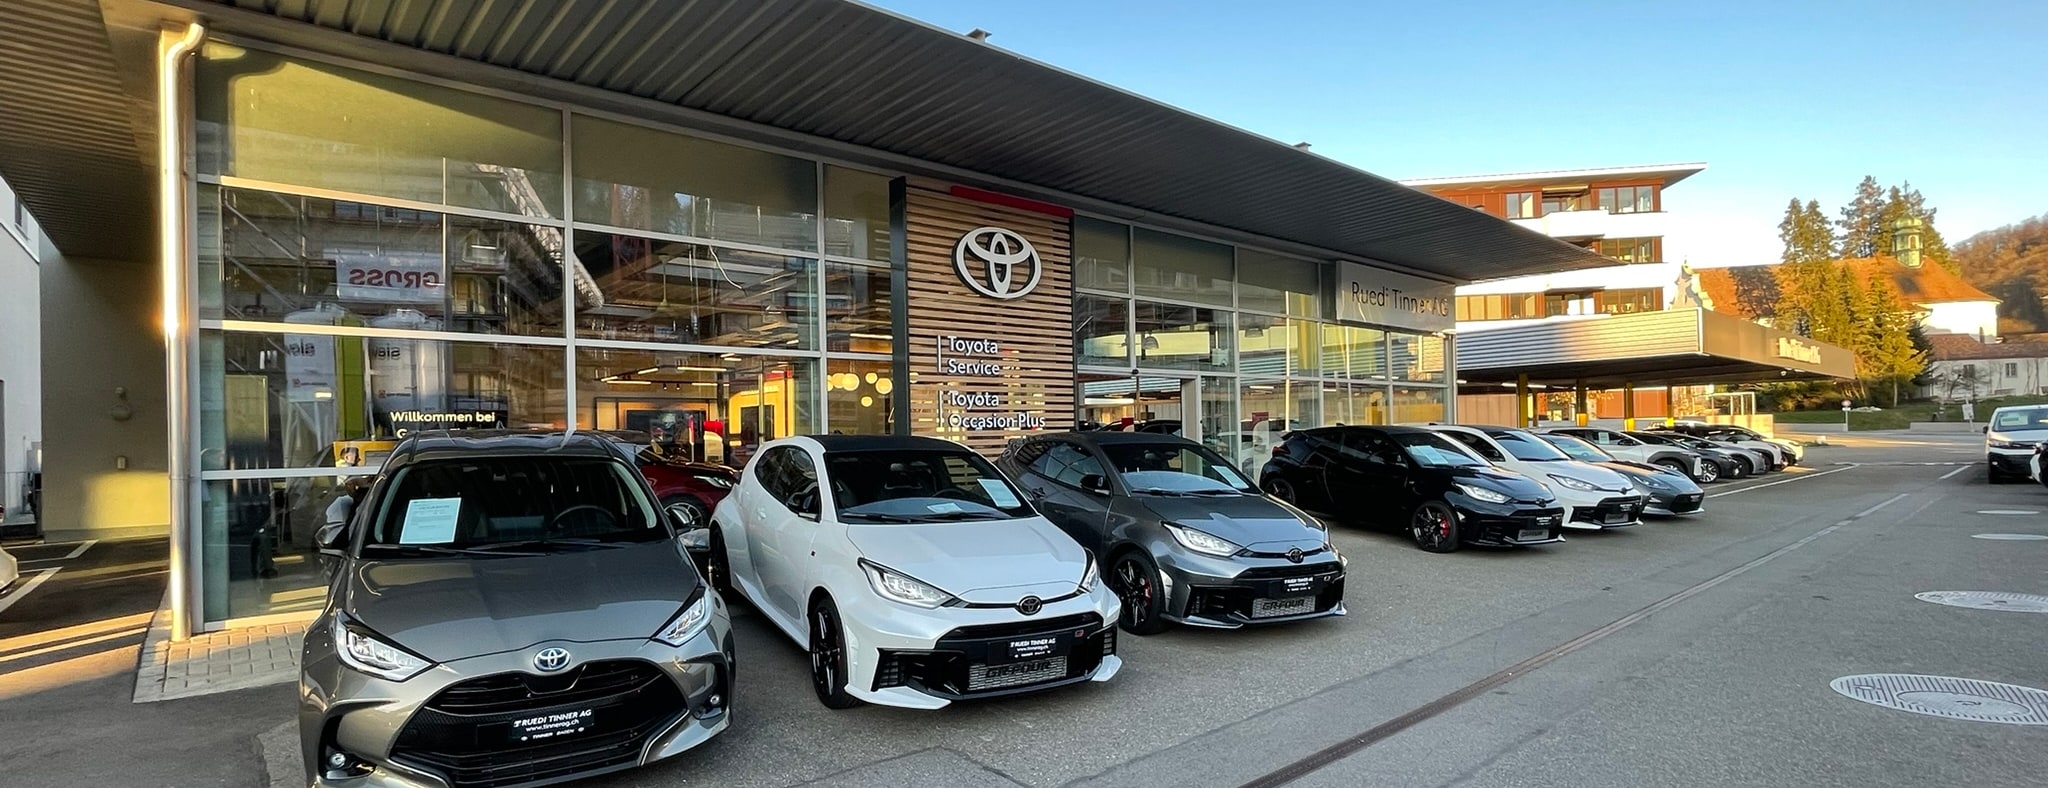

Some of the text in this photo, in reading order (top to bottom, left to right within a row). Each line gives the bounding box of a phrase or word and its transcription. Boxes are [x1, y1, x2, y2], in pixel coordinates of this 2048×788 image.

[947, 335, 998, 356] Toyota
[948, 358, 1000, 375] Service
[949, 390, 999, 410] Toyota
[390, 411, 495, 422] Willkommen bei
[949, 411, 1046, 428] Occasion Plus
[521, 709, 592, 726] RUEDI TINNER AG
